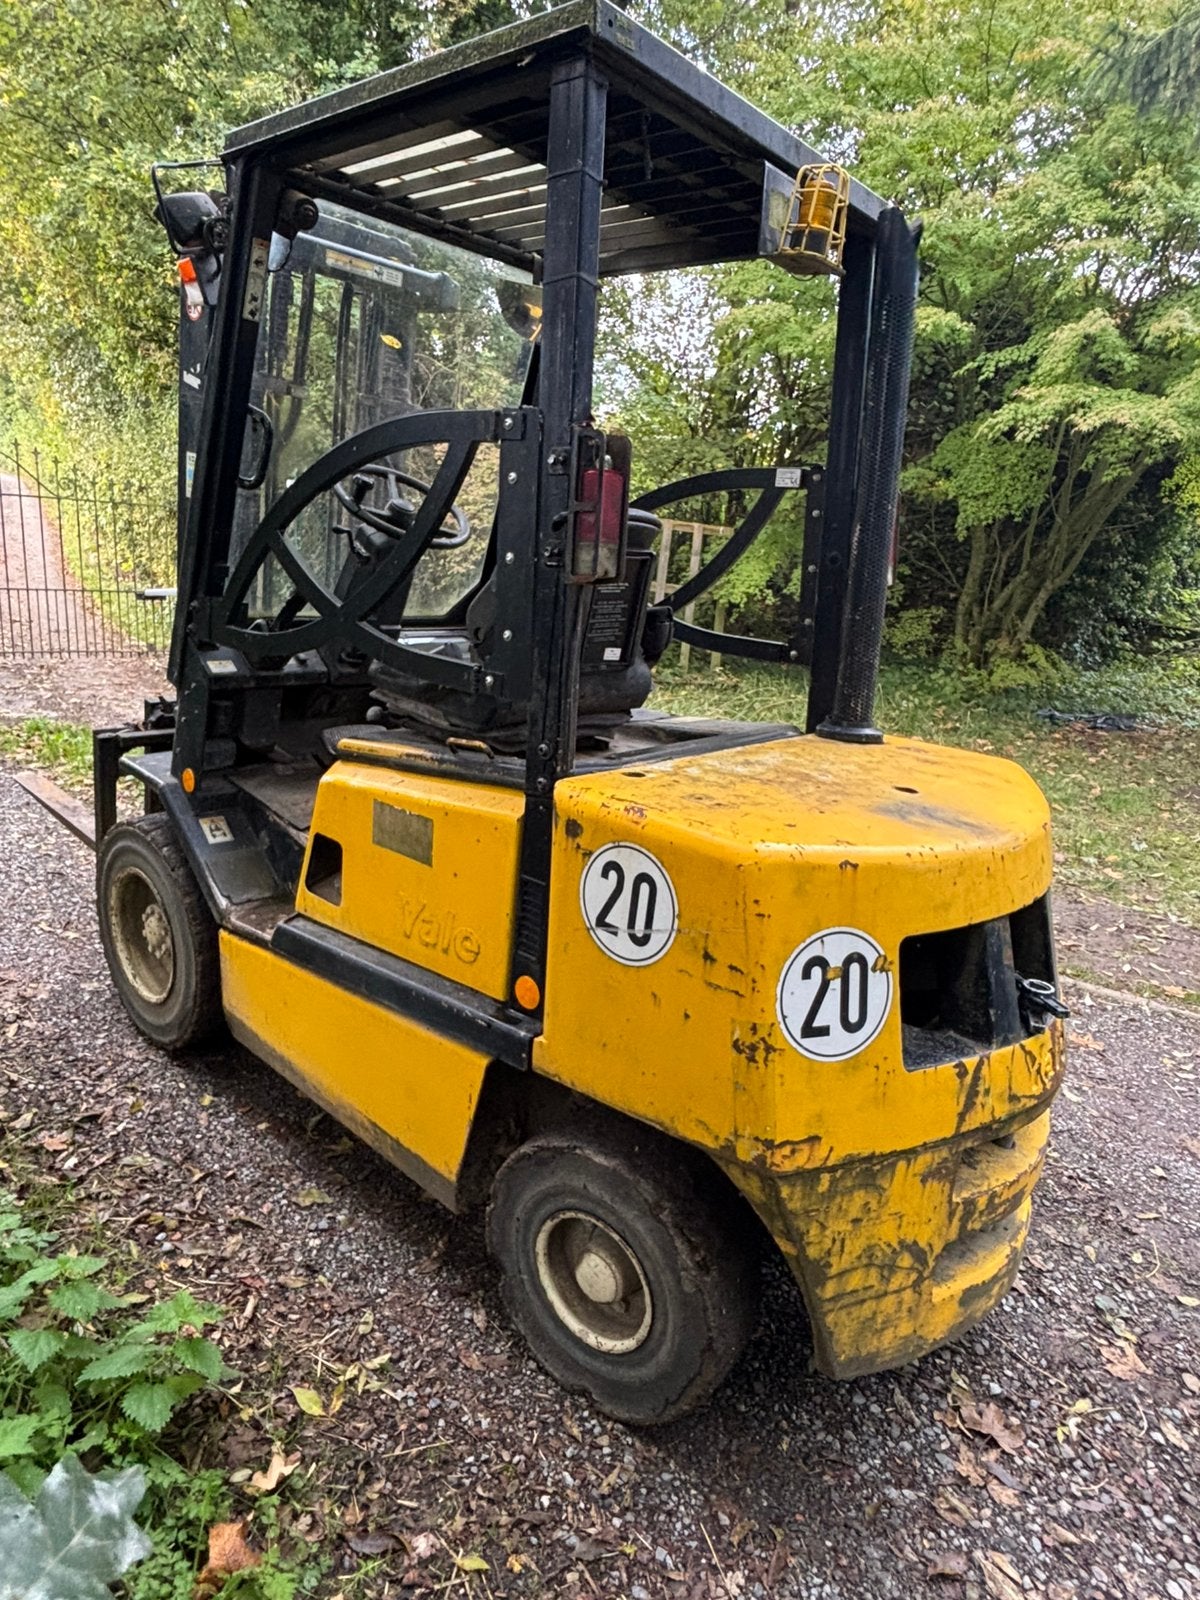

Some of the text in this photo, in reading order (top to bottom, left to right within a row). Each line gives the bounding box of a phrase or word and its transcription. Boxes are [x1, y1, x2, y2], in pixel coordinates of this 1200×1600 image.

[397, 893, 481, 963] Yale
[595, 860, 657, 947] 20
[800, 951, 868, 1039] 20
